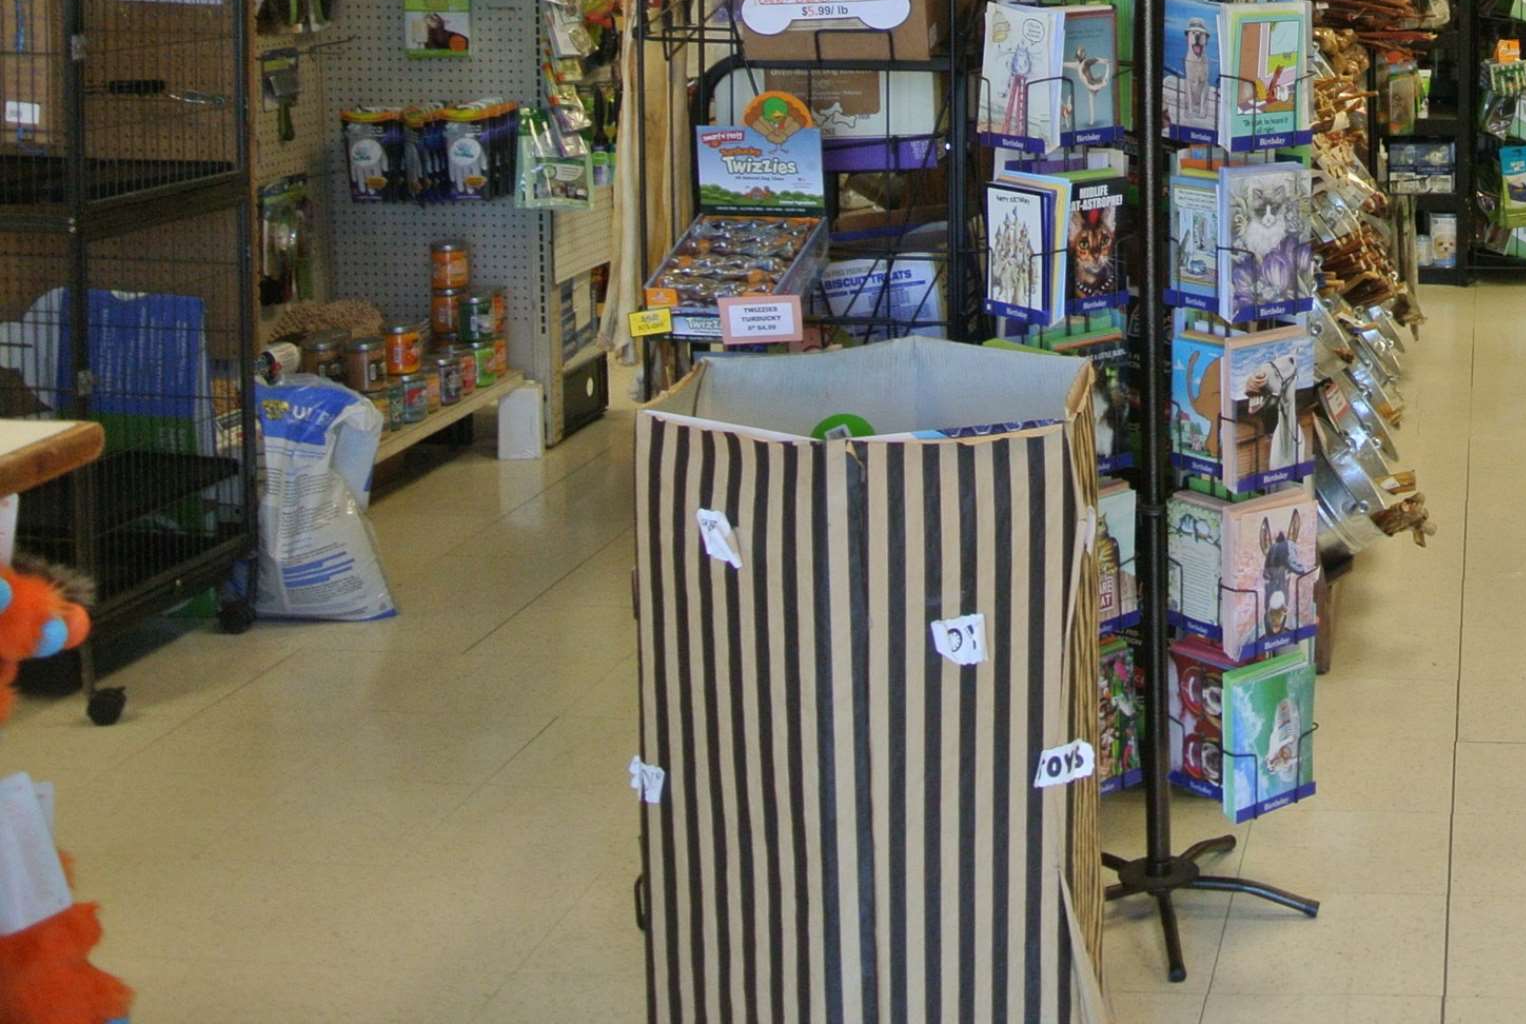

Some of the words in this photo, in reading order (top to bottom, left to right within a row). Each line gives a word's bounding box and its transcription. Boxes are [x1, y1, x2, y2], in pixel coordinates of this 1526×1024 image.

[837, 4, 849, 16] lb
[1259, 136, 1286, 147] Birthday
[1078, 184, 1109, 199] MIDLIFE
[1071, 193, 1124, 212] AT-ASTROPHE!
[1039, 744, 1085, 780] OYS
